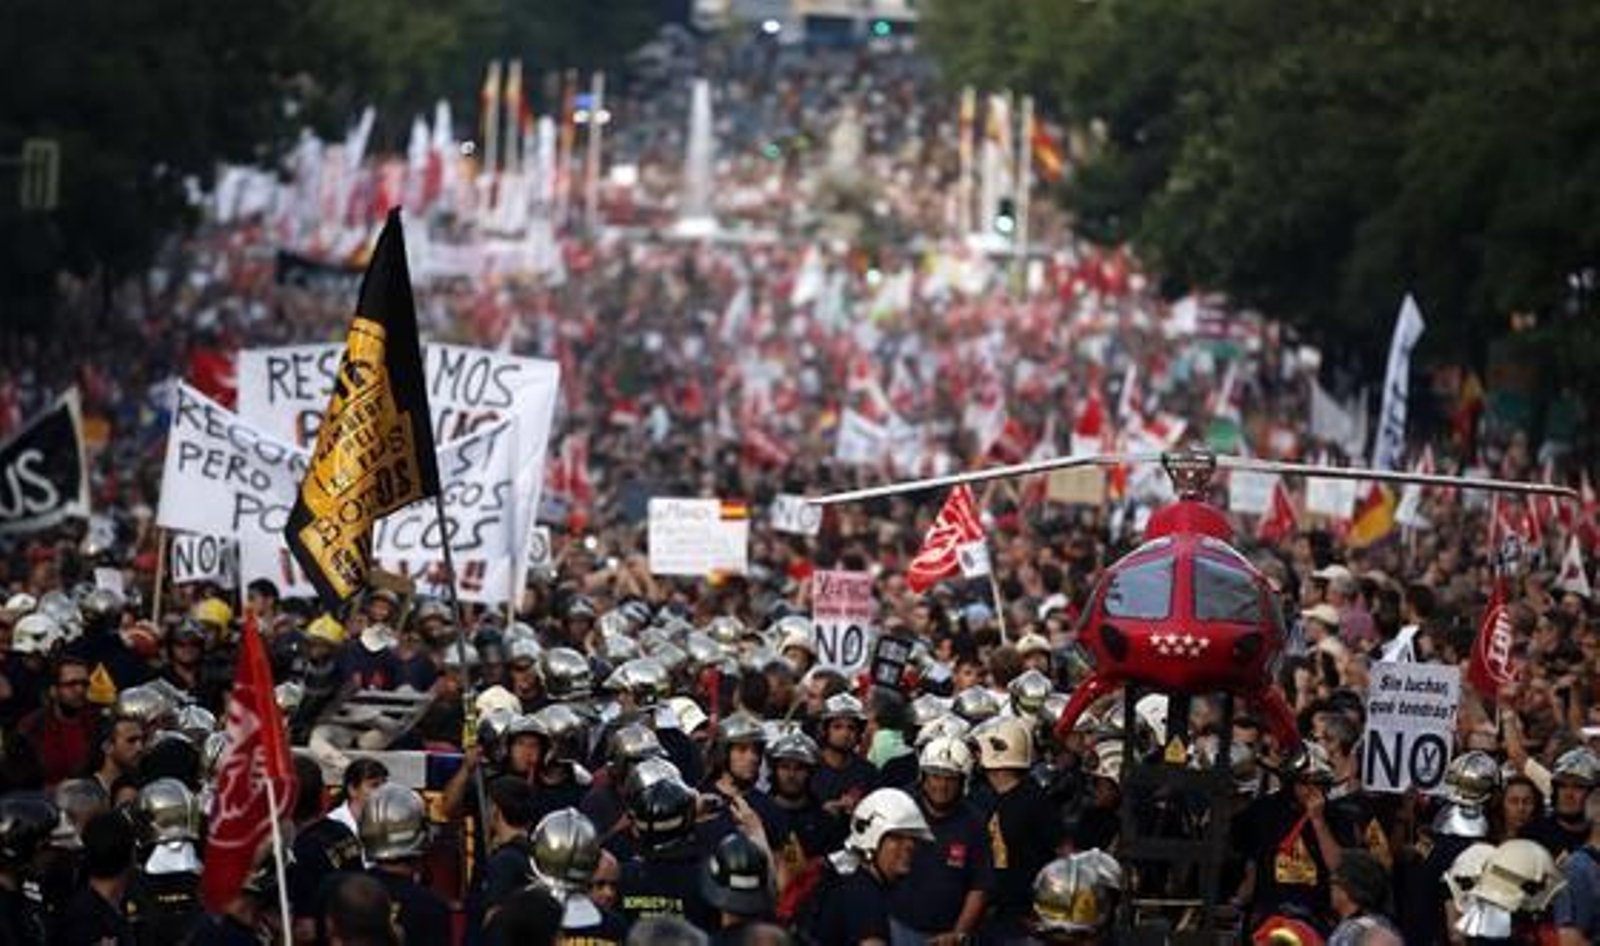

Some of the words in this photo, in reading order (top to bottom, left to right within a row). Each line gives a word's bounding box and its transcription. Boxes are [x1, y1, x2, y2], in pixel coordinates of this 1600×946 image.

[267, 348, 336, 403] RES
[432, 347, 522, 408] MOS
[179, 441, 272, 491] PERO
[376, 515, 501, 552] ICOS
[816, 624, 864, 667] NO
[1366, 730, 1449, 788] NO
